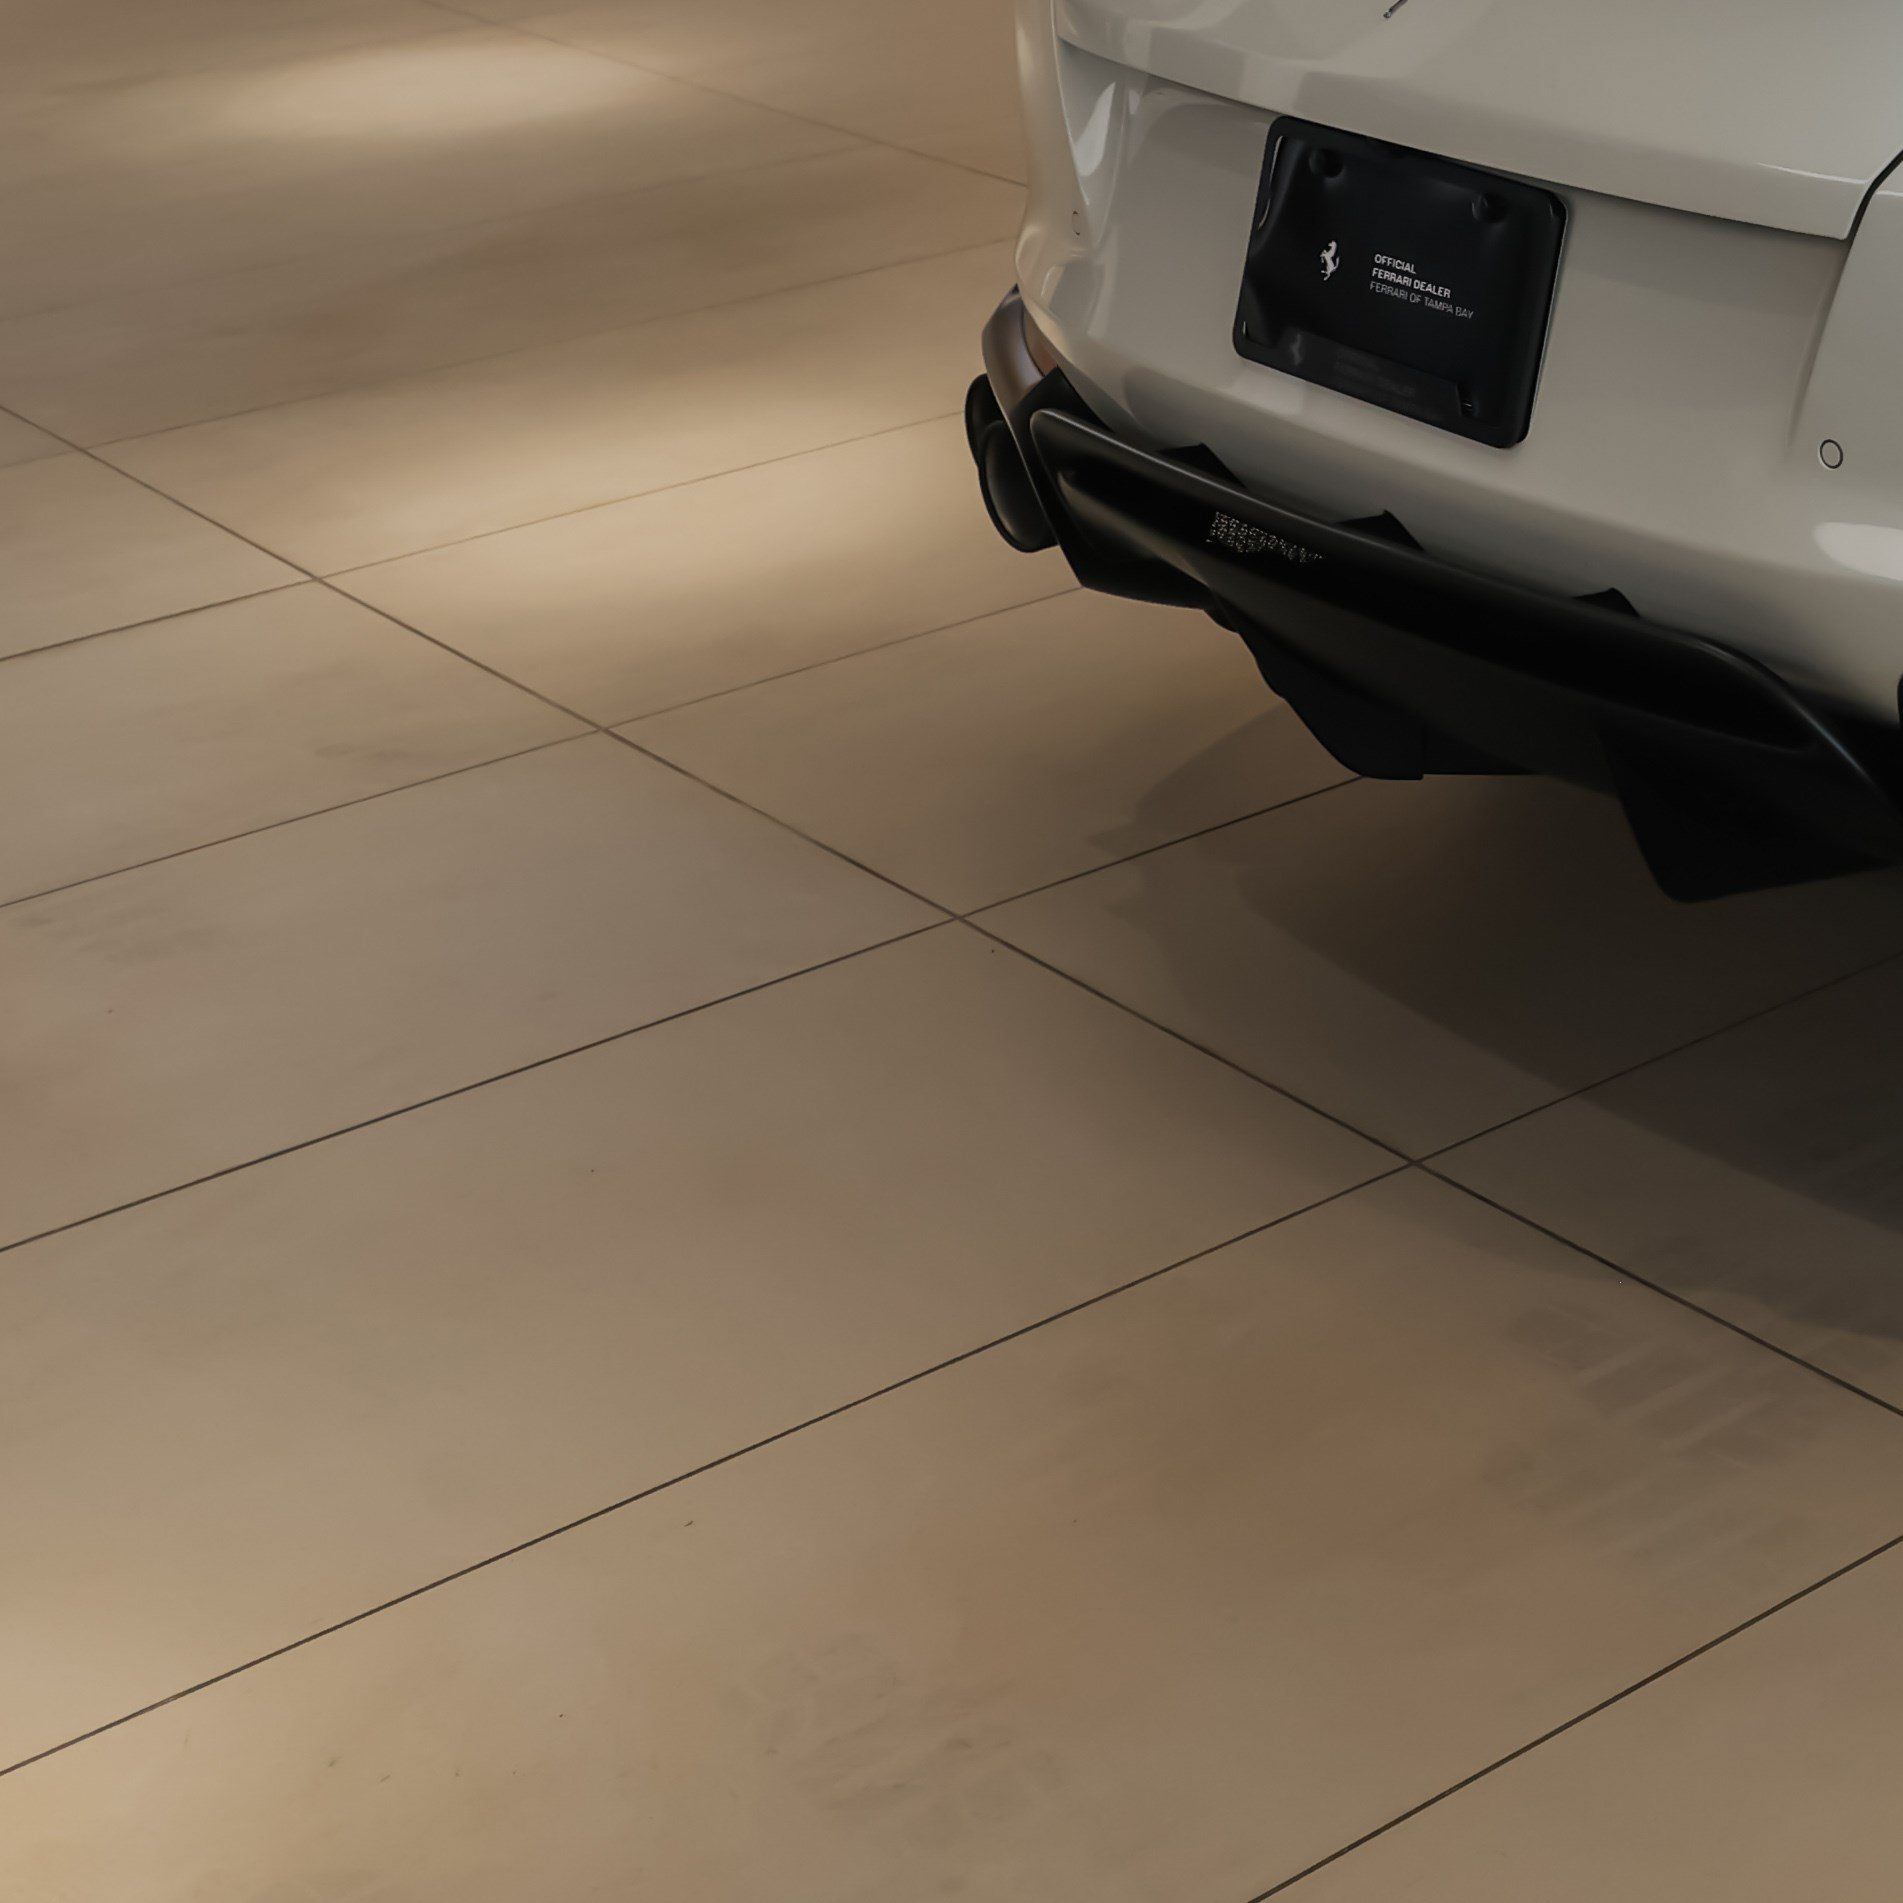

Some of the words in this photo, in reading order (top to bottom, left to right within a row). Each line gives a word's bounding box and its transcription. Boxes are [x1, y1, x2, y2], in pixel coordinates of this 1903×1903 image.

[1374, 253, 1417, 275] OFFICIAL
[1372, 267, 1412, 288] FERRARI
[1413, 279, 1451, 299] DEALER
[1369, 280, 1408, 301] FERRARI
[1409, 292, 1422, 304] OF
[1424, 296, 1454, 314] TAMPA
[1455, 306, 1474, 319] BAY
